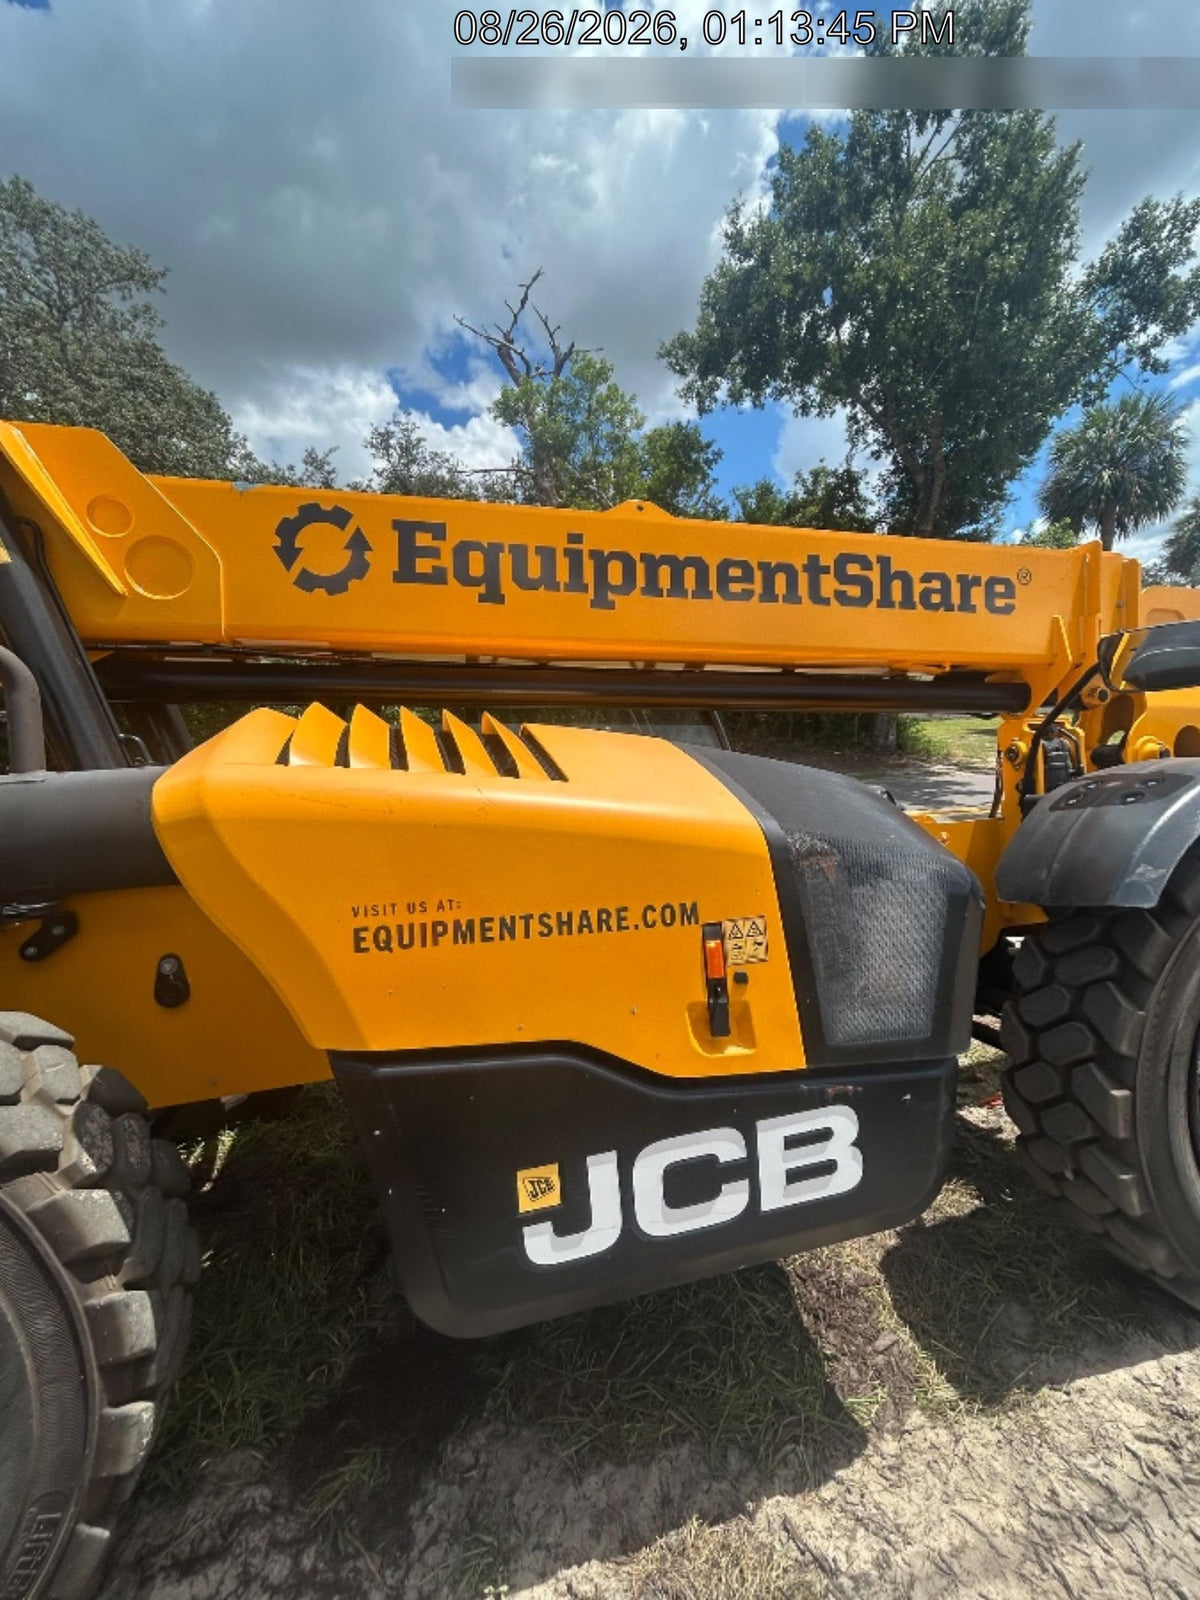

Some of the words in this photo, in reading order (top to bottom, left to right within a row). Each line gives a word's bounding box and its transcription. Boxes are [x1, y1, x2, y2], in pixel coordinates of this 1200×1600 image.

[351, 903, 397, 918] VISIT
[407, 901, 428, 914] US
[436, 899, 461, 913] AT:
[353, 901, 699, 954] EQUIPMENTSHARE.COM
[522, 1104, 864, 1266] JCB
[527, 1179, 555, 1199] JCB
